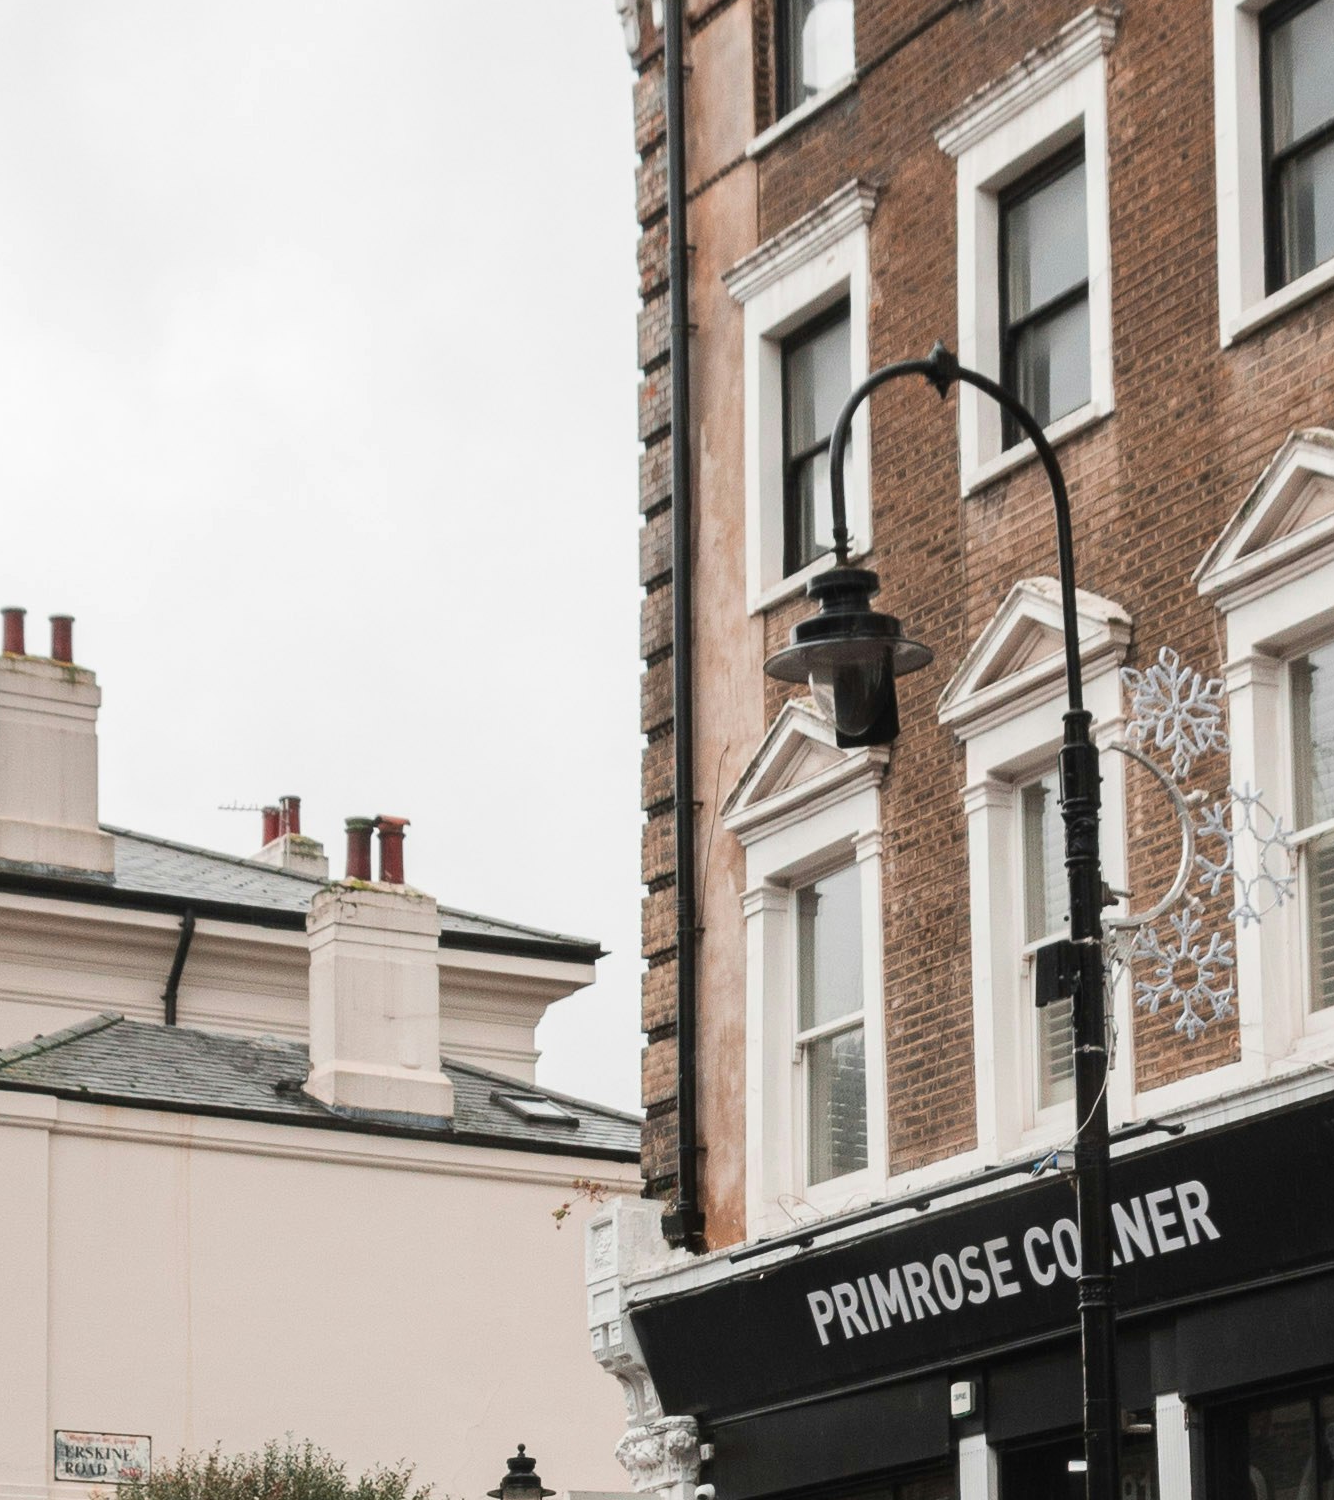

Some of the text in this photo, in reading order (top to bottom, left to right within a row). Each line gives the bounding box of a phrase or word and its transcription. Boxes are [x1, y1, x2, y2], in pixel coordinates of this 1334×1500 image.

[806, 1180, 1221, 1346] PRIMROSE CONER
[64, 1445, 133, 1462] ERSKINE
[64, 1461, 108, 1477] ROAD
